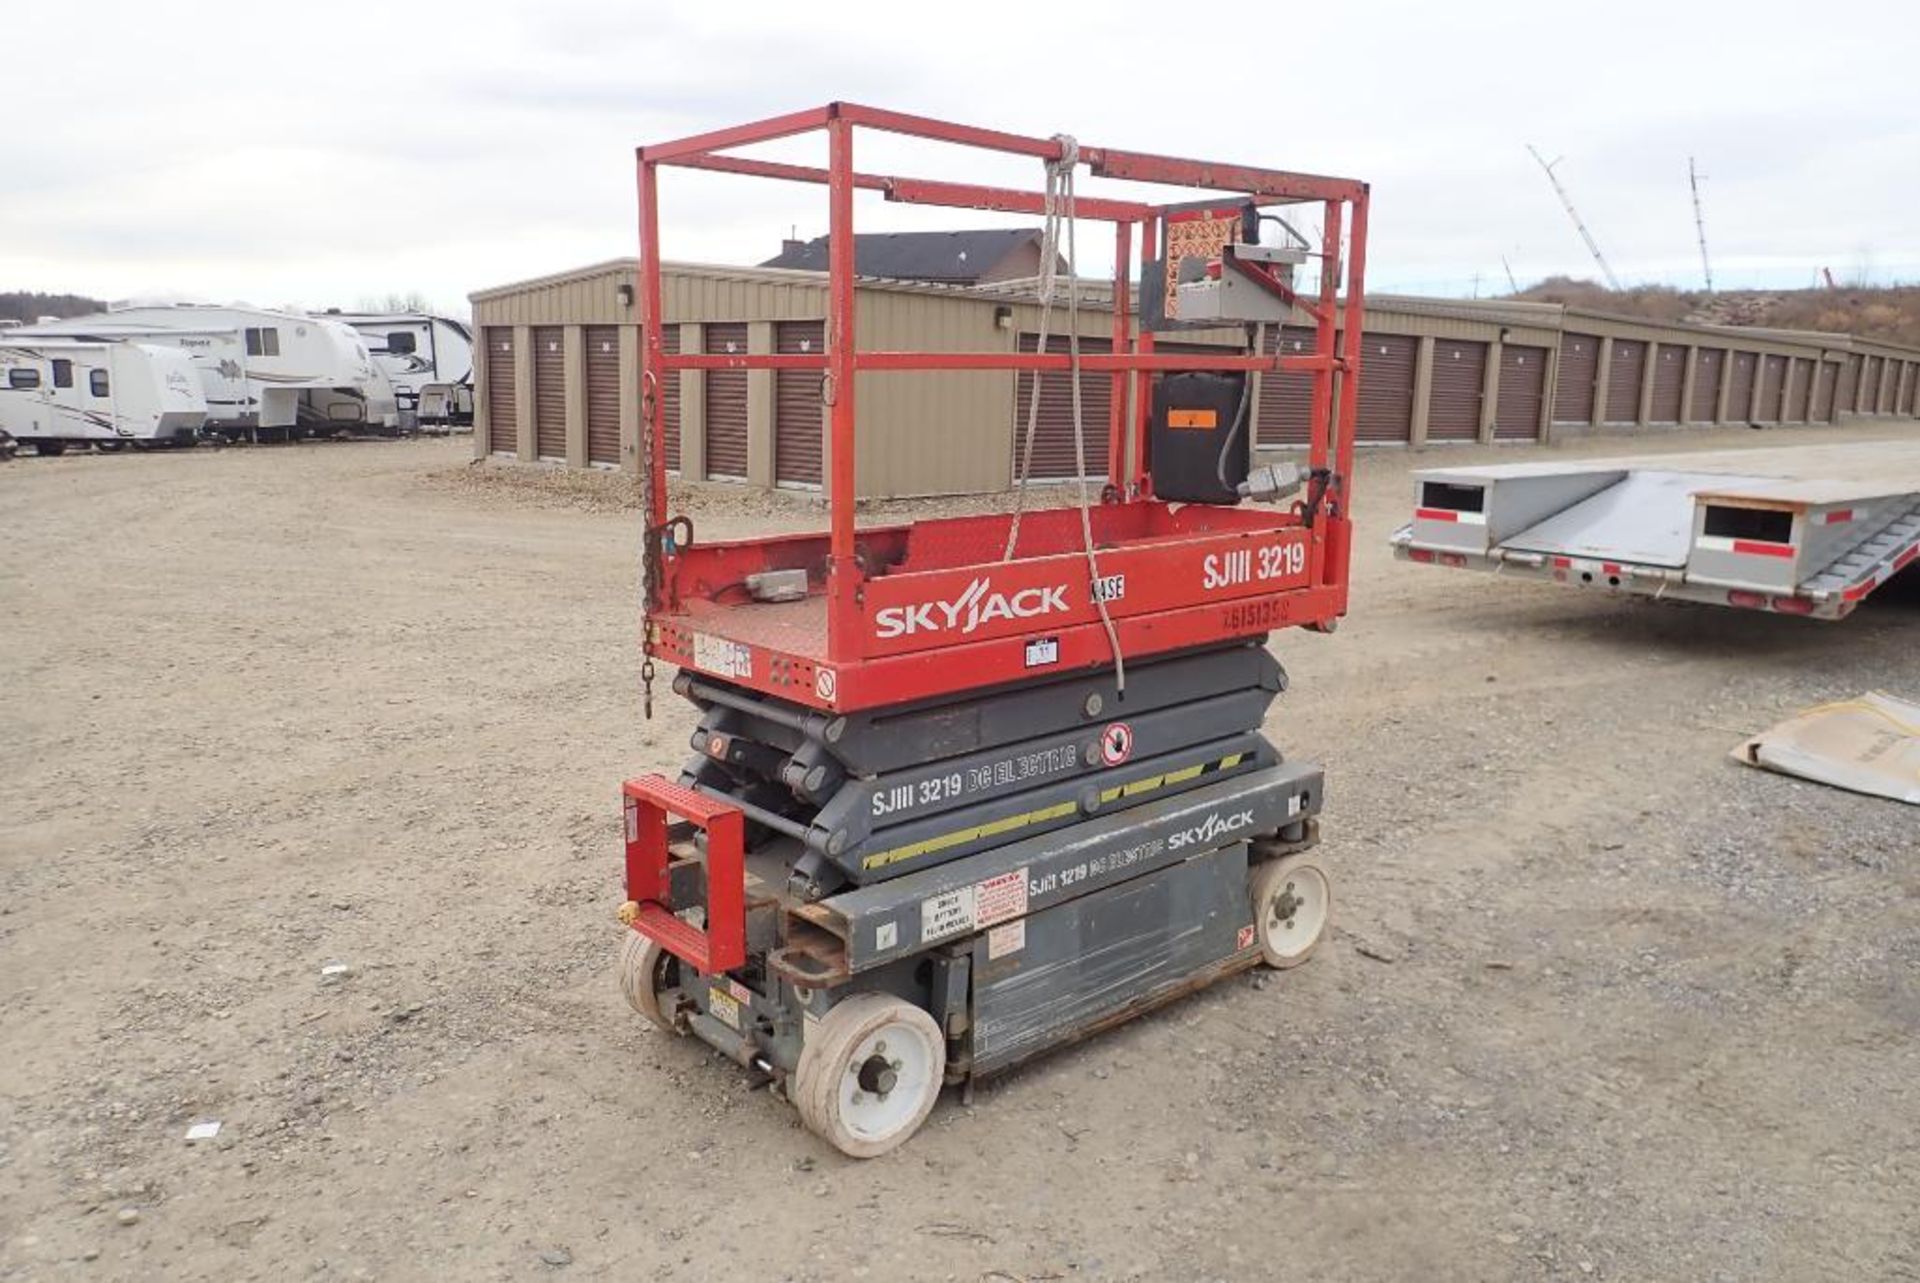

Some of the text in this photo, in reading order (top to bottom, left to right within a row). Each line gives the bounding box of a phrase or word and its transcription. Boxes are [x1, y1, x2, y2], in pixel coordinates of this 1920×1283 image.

[1203, 542, 1305, 590] SJIII 3219
[875, 576, 1071, 639] SKYJACK
[872, 784, 914, 816] SJIII
[919, 773, 962, 804] 3219
[966, 766, 992, 793] DC
[1168, 809, 1254, 851] SKYJACK
